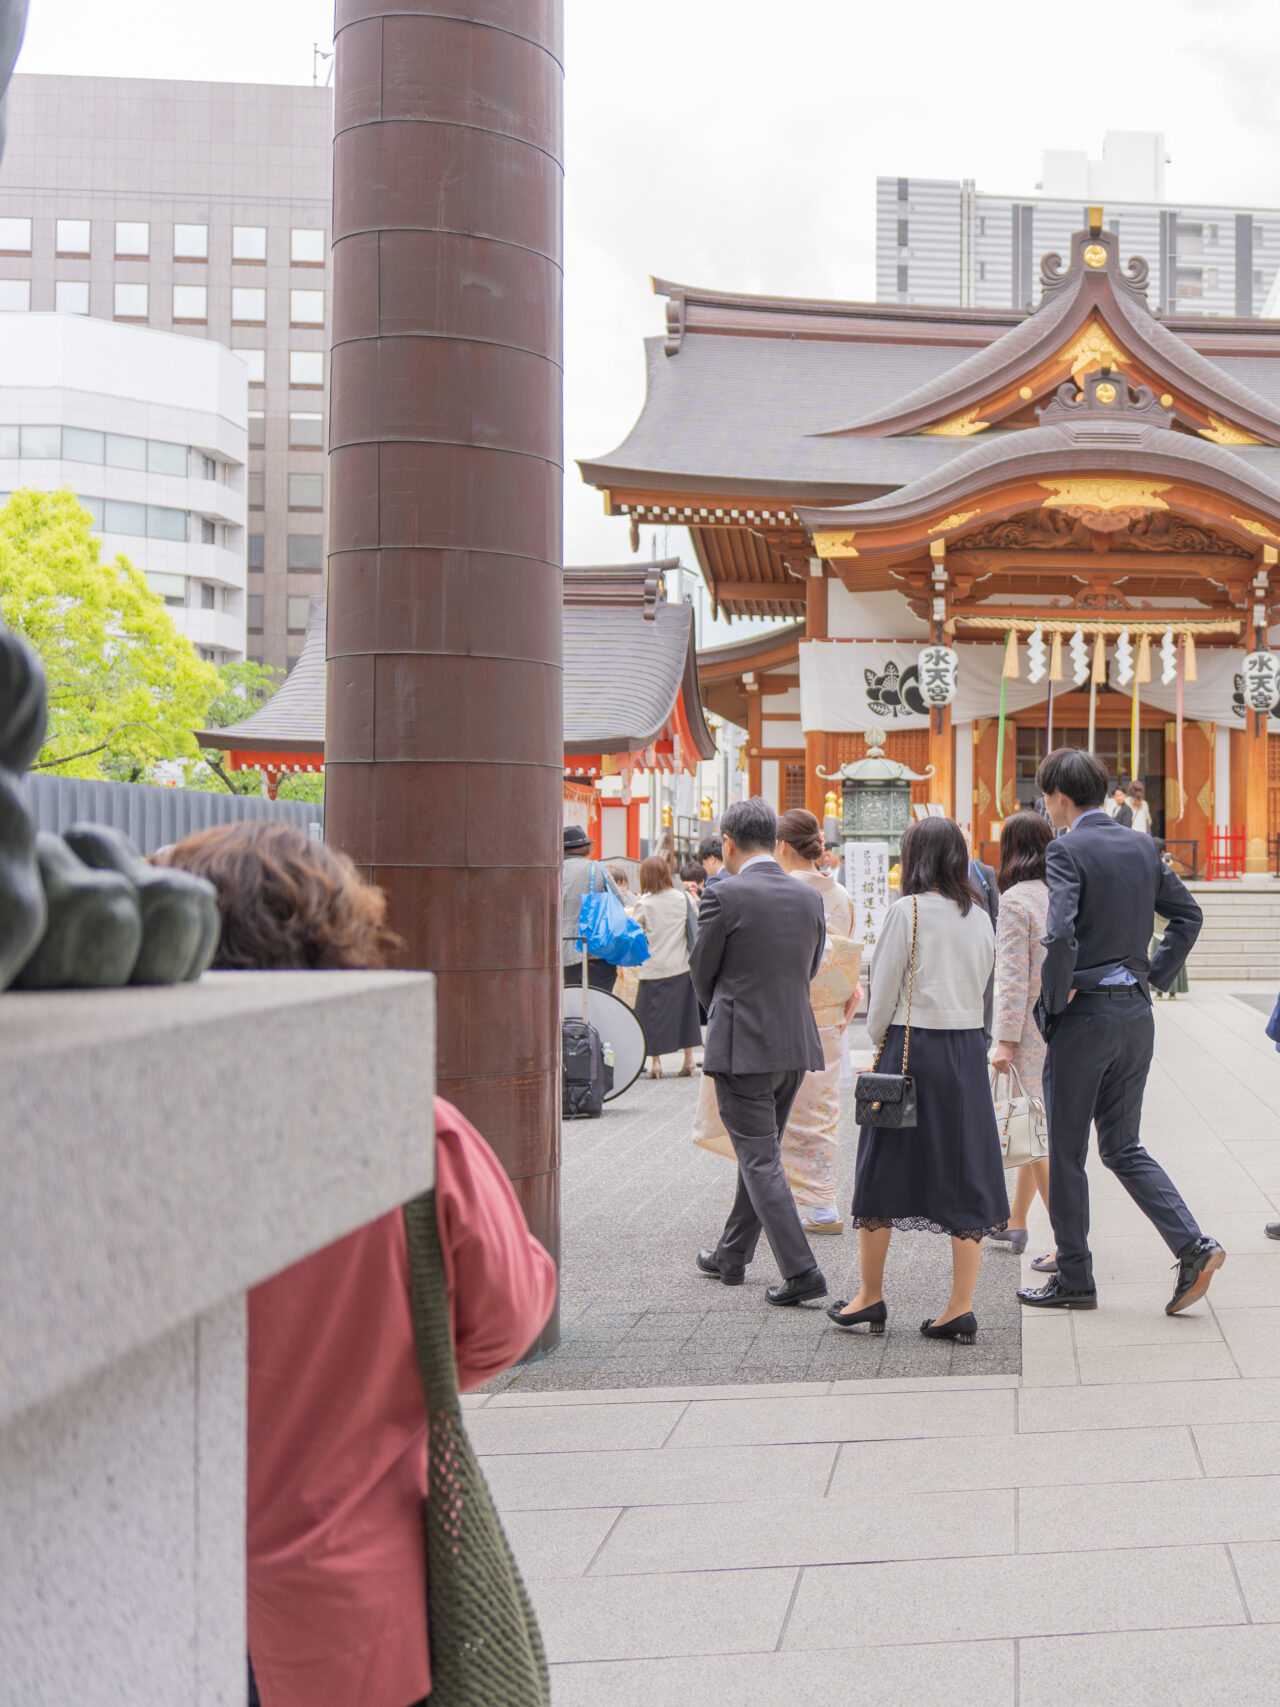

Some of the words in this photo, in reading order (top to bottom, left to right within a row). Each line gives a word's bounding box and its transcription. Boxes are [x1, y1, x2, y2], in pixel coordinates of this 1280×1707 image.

[924, 649, 950, 702] 水天宮
[1248, 655, 1273, 708] 水天宮
